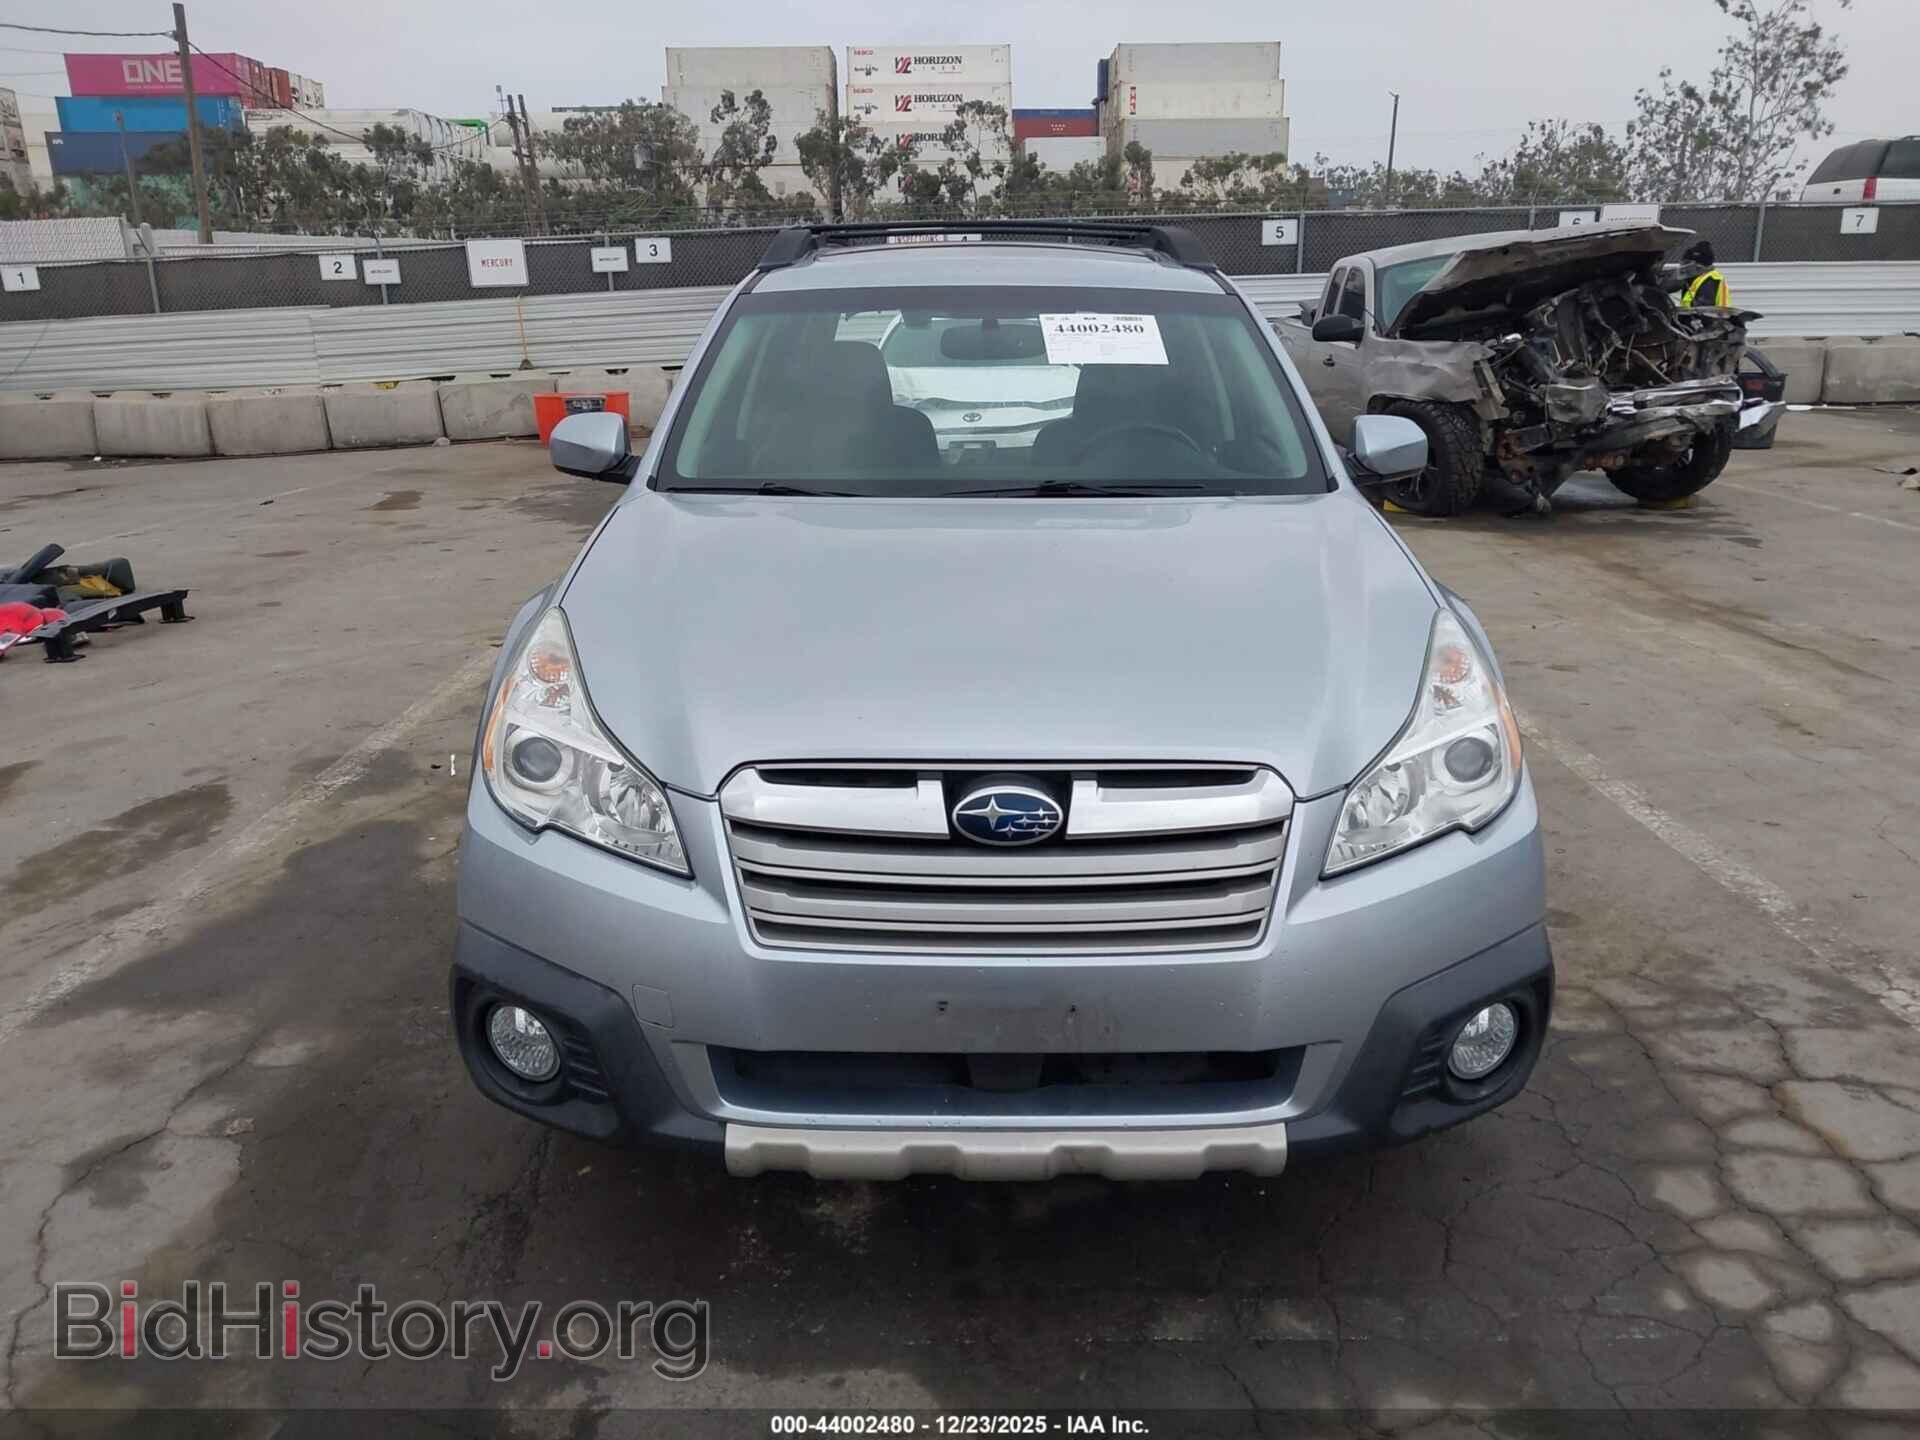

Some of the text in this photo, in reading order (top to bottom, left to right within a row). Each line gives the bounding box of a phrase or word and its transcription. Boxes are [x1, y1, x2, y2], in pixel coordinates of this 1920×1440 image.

[914, 56, 962, 64] HORIZON
[122, 59, 183, 83] ONE
[914, 94, 963, 103] HORIZON
[1856, 214, 1864, 228] 7
[1275, 226, 1284, 239] 5
[649, 244, 658, 257] 3
[333, 261, 343, 274] 2
[481, 258, 512, 268] MERCURY
[17, 271, 25, 285] 1
[1053, 323, 1145, 334] 44002480
